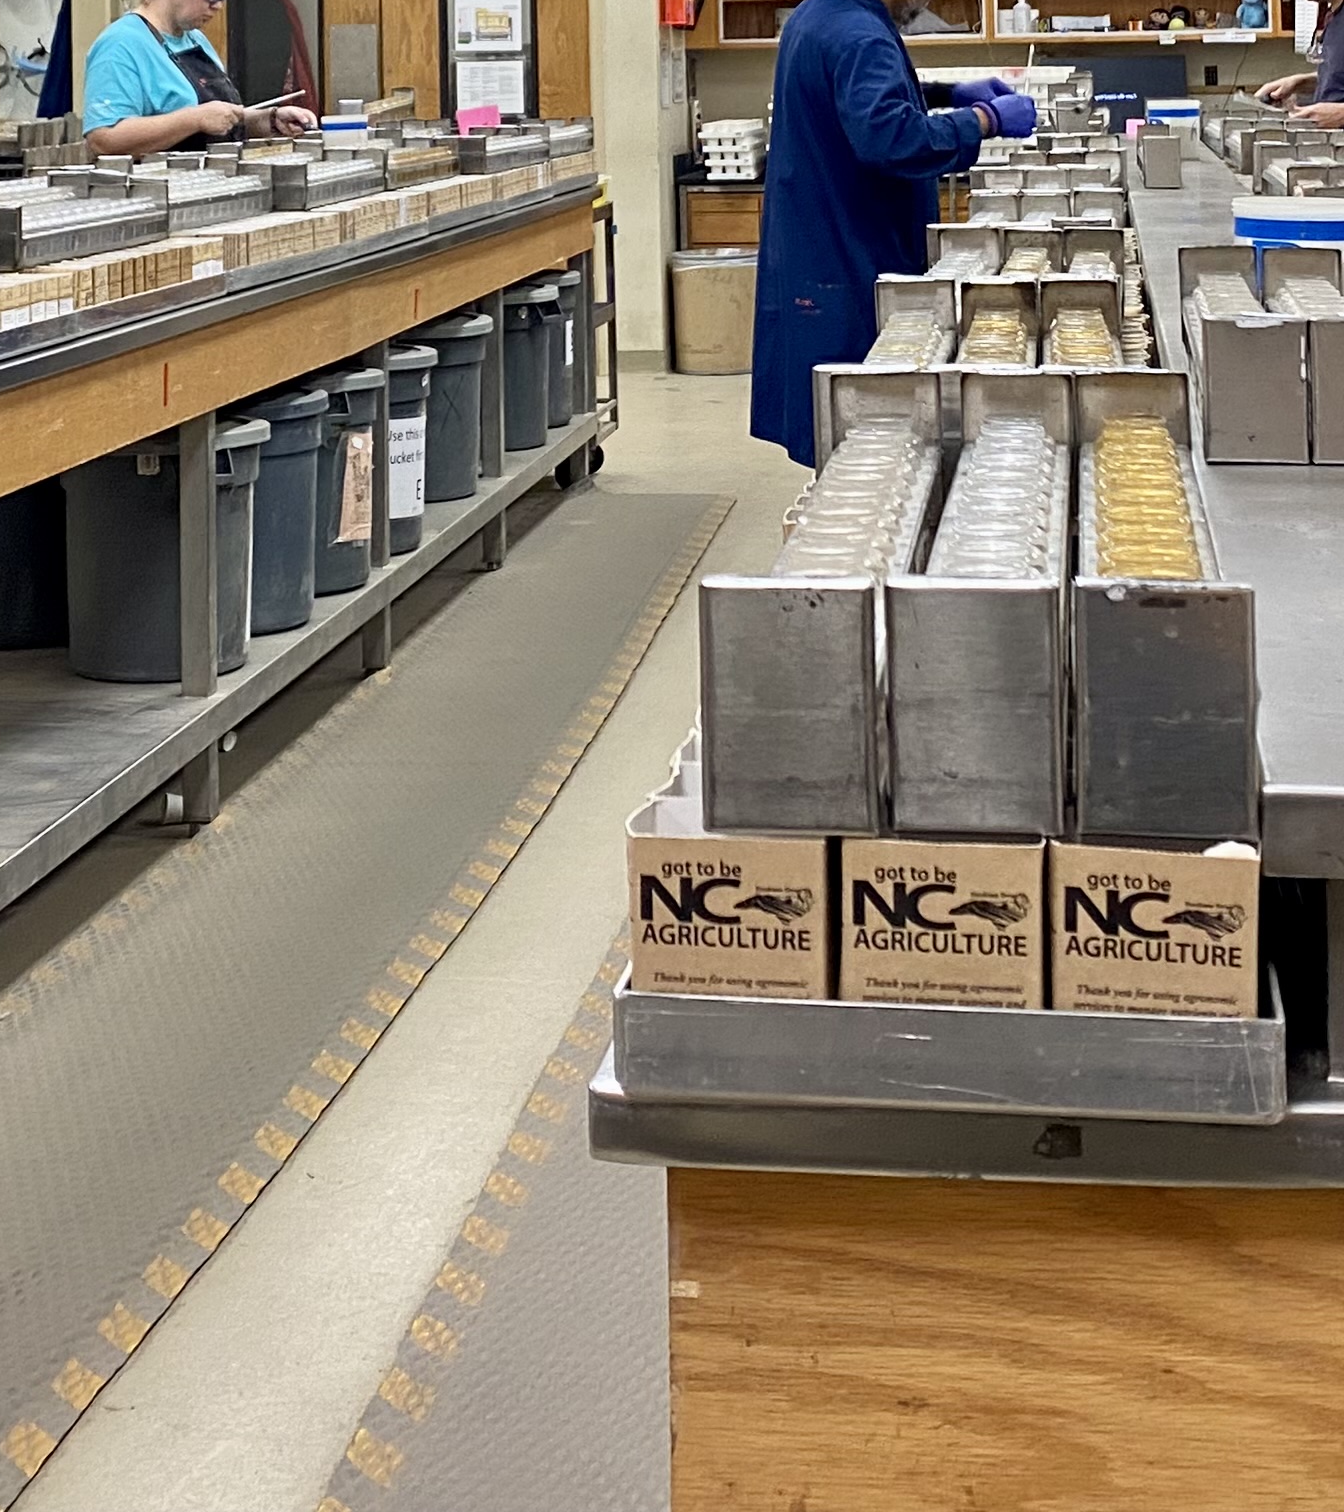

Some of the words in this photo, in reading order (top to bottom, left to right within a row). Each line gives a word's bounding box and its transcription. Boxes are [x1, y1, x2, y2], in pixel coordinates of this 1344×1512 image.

[662, 862, 691, 878] got
[697, 863, 714, 876] to
[720, 859, 741, 877] be
[875, 867, 905, 884] got
[910, 867, 929, 881] to
[934, 865, 956, 883] be
[1087, 874, 1119, 890] got
[1124, 875, 1143, 889] to
[1149, 874, 1171, 891] be
[640, 873, 741, 924] NC
[853, 879, 957, 931] NC
[1064, 886, 1170, 939] NC
[642, 923, 811, 951] AGRICULTURE
[854, 928, 1028, 957] AGRICULTURE
[1066, 935, 1242, 968] AGRICULTURE
[654, 972, 685, 983] Thank
[865, 977, 899, 988] Thank
[1078, 984, 1110, 995] Thank
